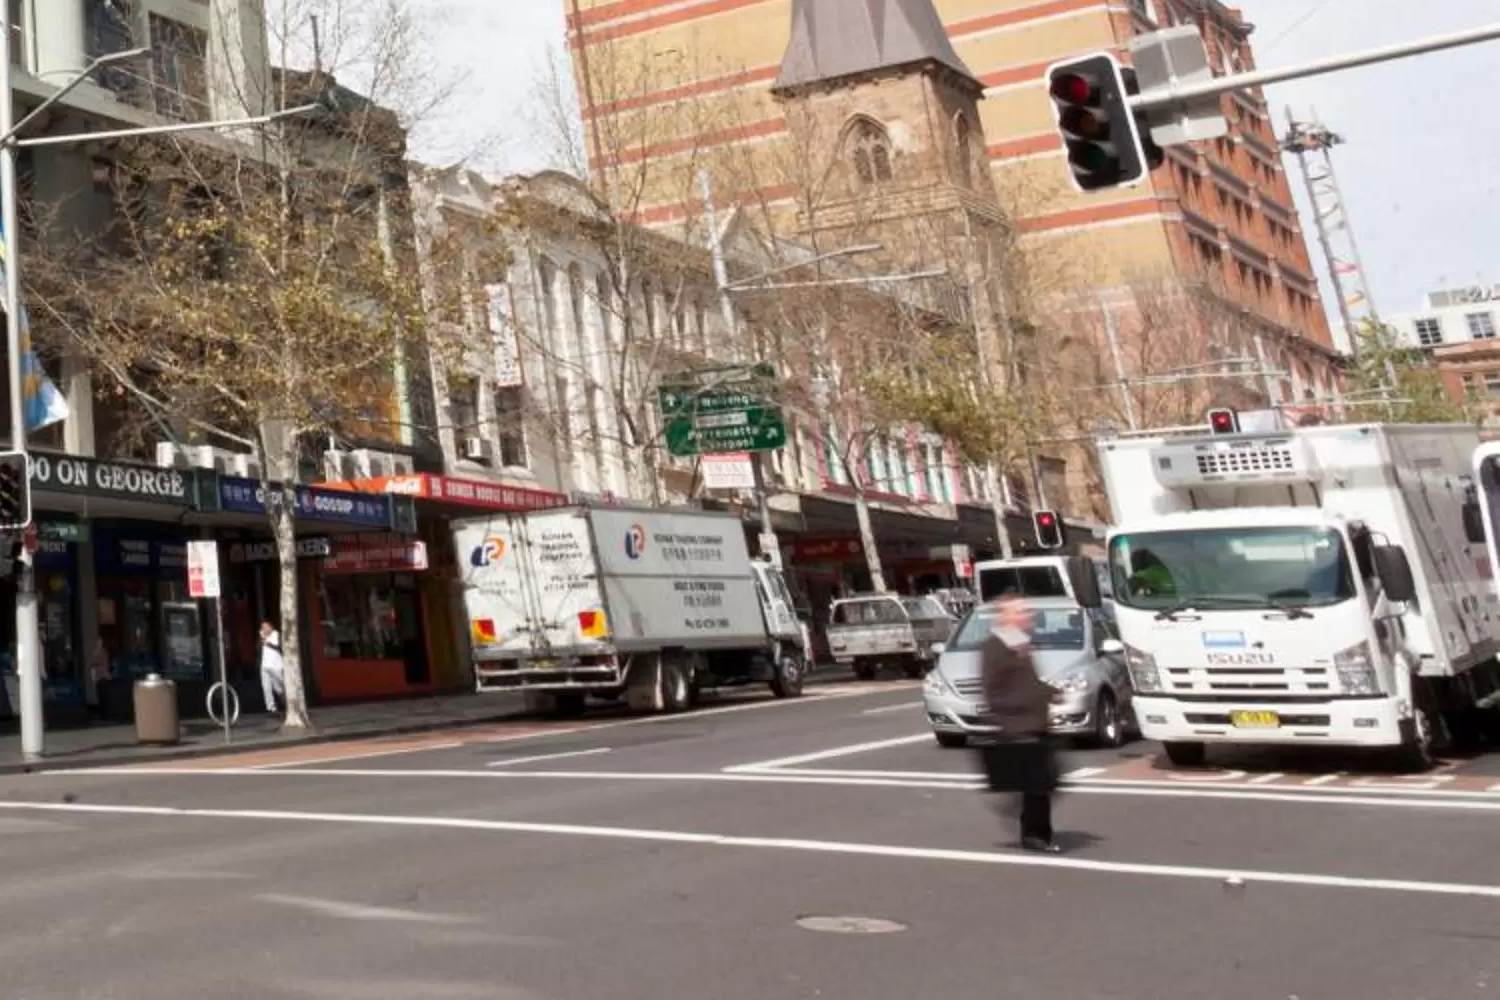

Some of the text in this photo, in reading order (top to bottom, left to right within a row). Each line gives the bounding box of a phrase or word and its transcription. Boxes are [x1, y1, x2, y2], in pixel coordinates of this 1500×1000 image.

[27, 456, 185, 497] 90 ON GEORGE
[256, 489, 300, 508] GOBL
[314, 496, 354, 513] GOSSIP
[246, 537, 330, 562] BACKKERS
[1206, 653, 1274, 664] ISUZU
